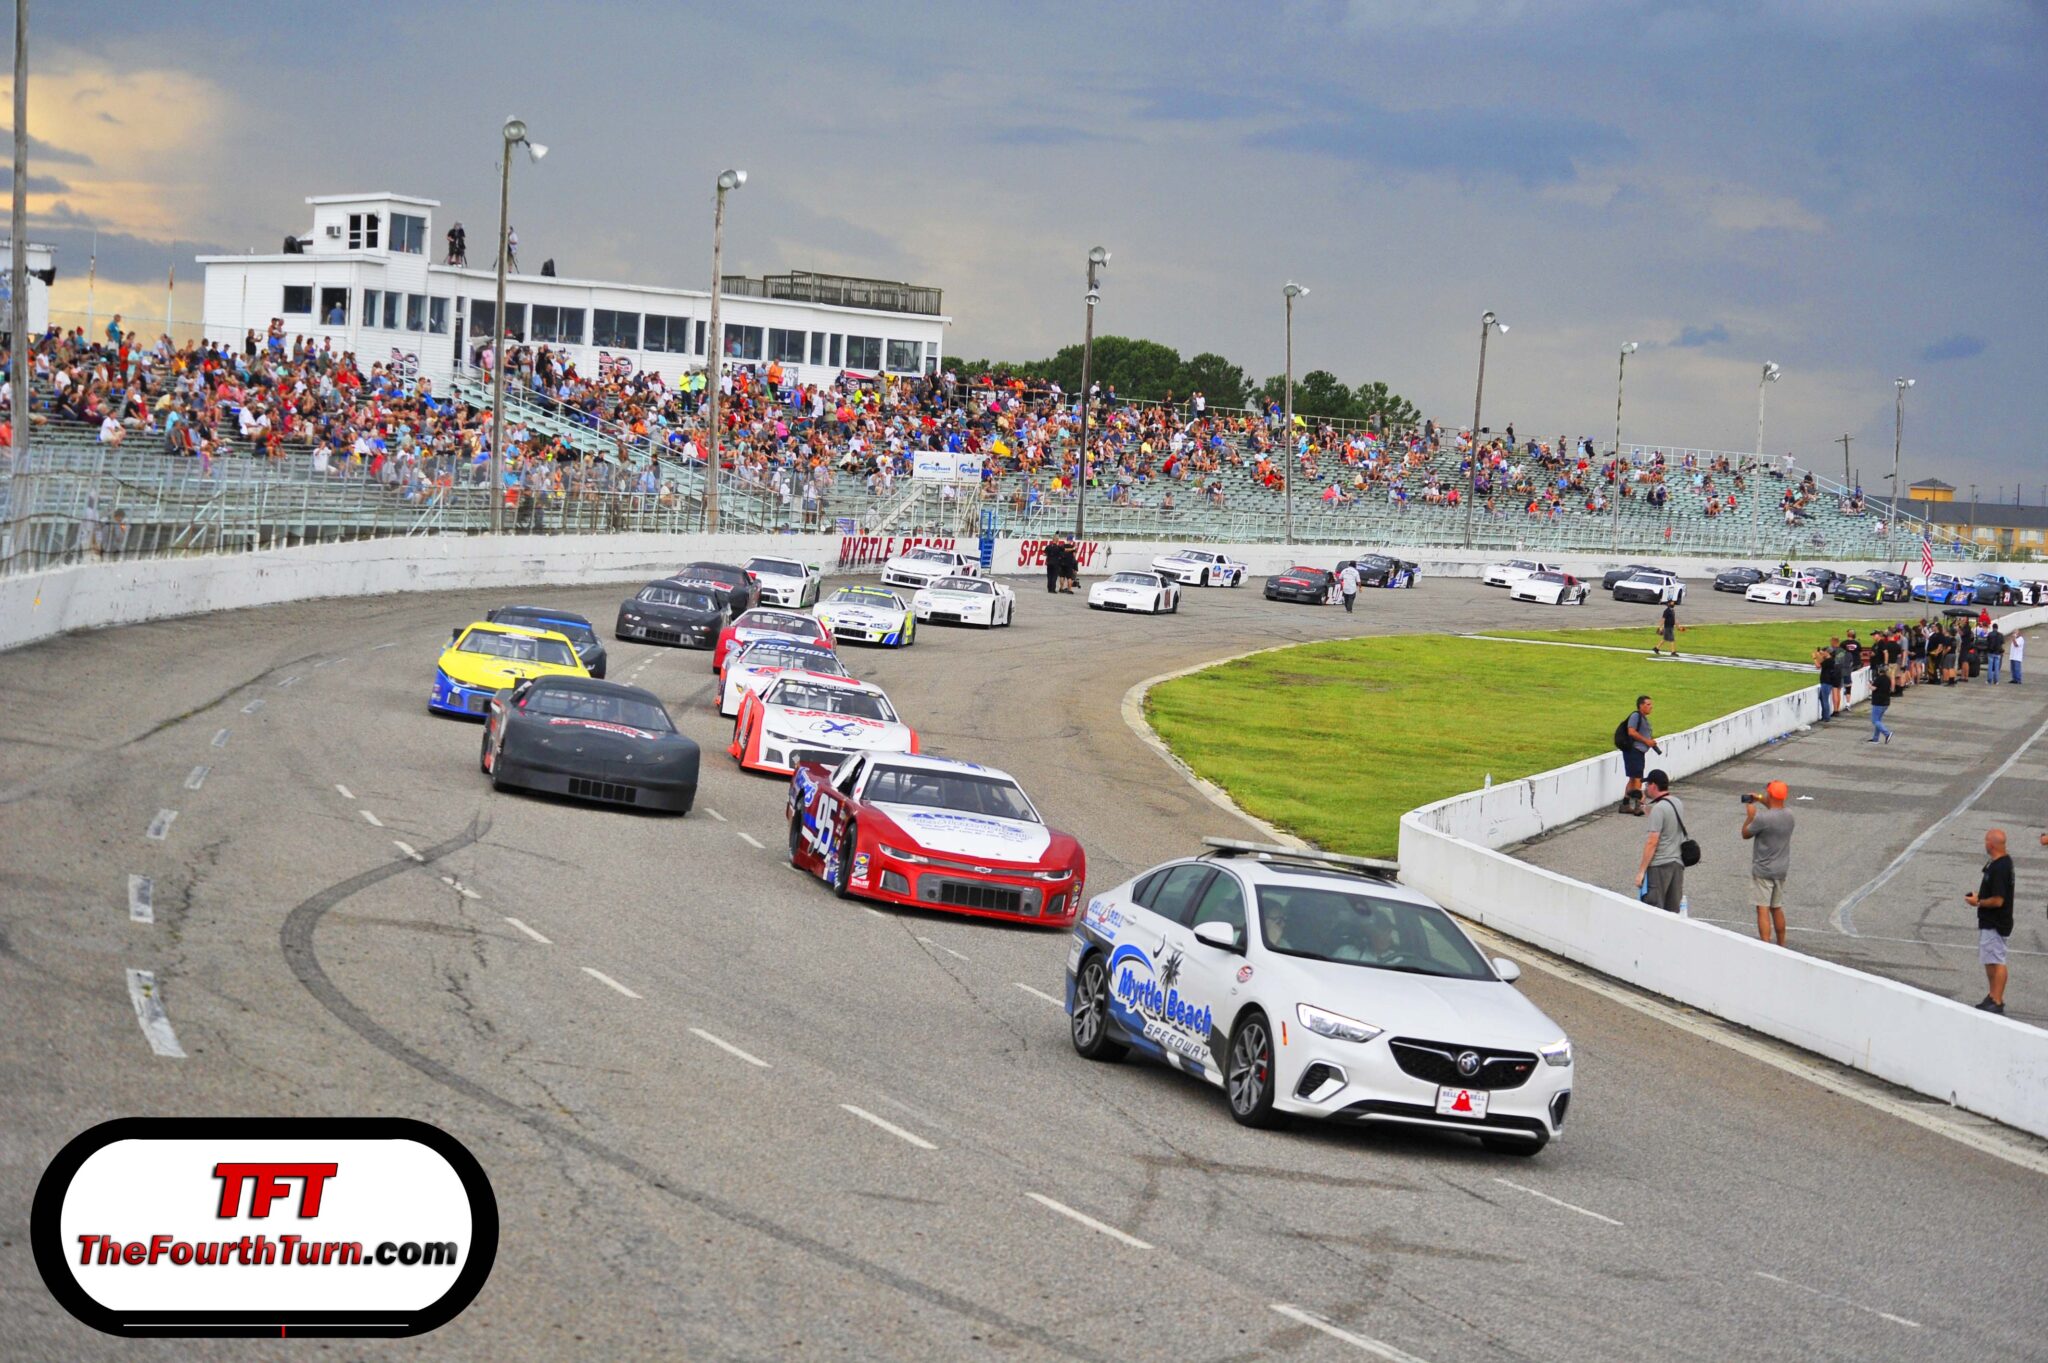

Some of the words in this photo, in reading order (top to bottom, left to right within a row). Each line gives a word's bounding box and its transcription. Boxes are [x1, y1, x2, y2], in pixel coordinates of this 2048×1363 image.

[839, 536, 894, 567] MYRTLE
[1018, 539, 1098, 567] SPEAY
[756, 642, 833, 659] MCCASKILL
[801, 793, 838, 856] 95
[1117, 967, 1162, 1011] Myrtle
[1166, 989, 1212, 1036] Beach
[1146, 1023, 1209, 1060] SPEEDWAY
